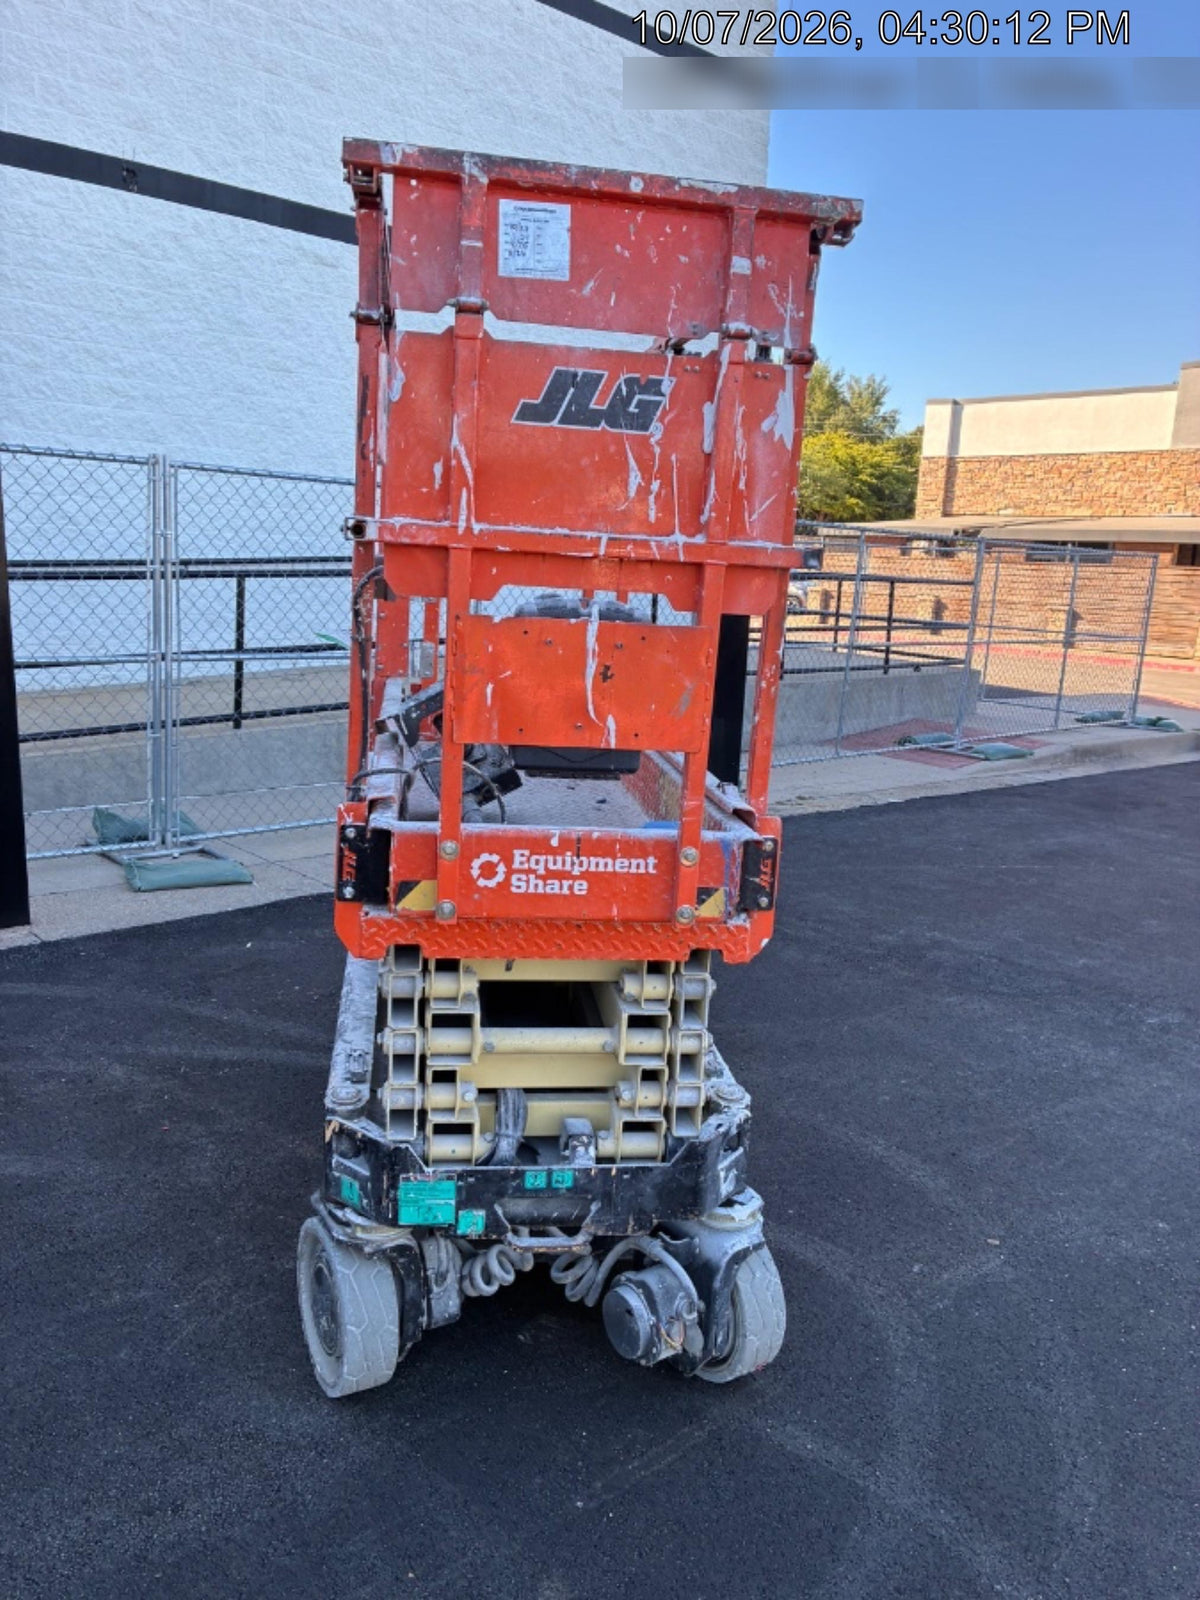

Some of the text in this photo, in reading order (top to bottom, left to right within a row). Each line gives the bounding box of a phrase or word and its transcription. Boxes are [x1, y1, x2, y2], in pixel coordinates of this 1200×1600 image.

[511, 366, 676, 434] JLG
[512, 849, 658, 875] Equipment
[510, 874, 589, 895] Share
